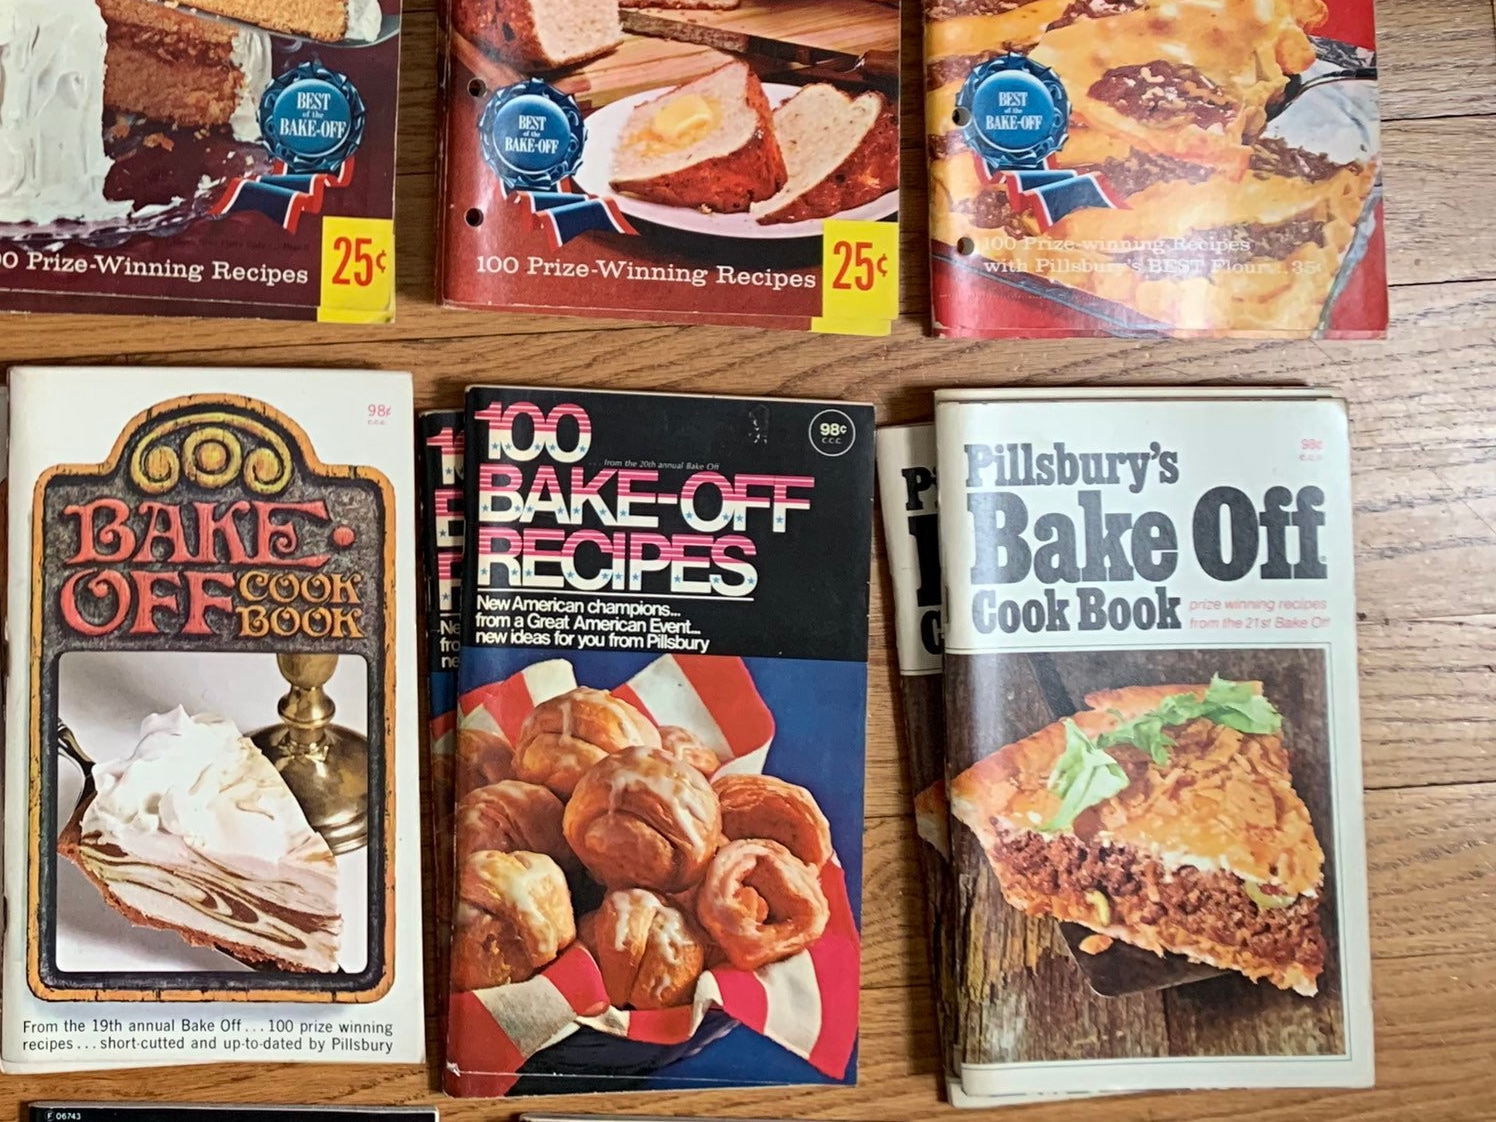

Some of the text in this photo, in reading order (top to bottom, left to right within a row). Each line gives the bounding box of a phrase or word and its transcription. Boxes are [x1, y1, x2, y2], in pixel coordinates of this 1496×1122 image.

[280, 118, 346, 138] BAKE-OFF
[985, 115, 1042, 130] BAKE-OFF
[26, 251, 204, 281] Prize-Winning
[211, 261, 308, 284] Recipes
[833, 241, 888, 291] 25¢
[474, 402, 592, 463] 100
[820, 423, 847, 437] 98¢
[964, 441, 1179, 493] Pillsbury's
[478, 463, 815, 533] BAKE-OFF
[966, 490, 1178, 585] Bake
[1192, 485, 1328, 582] Off
[478, 527, 758, 596] RECIPES
[61, 569, 236, 636] OFF
[239, 571, 363, 604] COOK
[236, 606, 364, 639] BOOK
[972, 588, 1070, 634] Cook
[1076, 586, 1181, 631] Book
[476, 629, 710, 653] new ideas for you from Pillsbury
[100, 1035, 184, 1049] short-cutted
[190, 1036, 217, 1050] and
[224, 1036, 303, 1052] up-to-dated
[309, 1036, 326, 1052] by
[331, 1037, 394, 1053] Pillsbury
